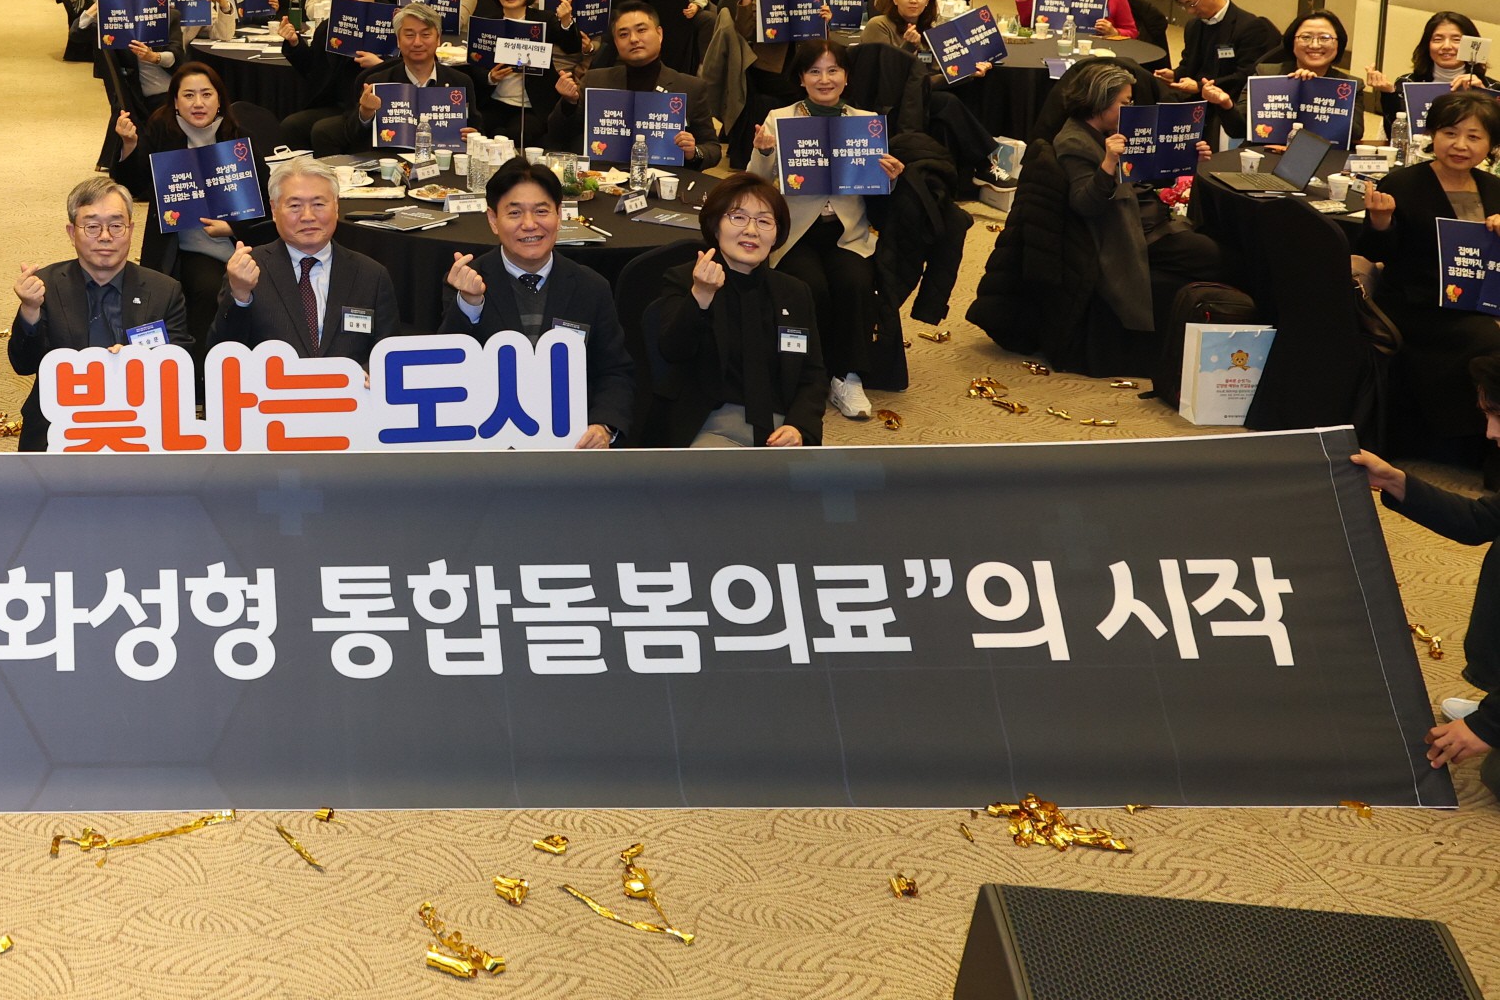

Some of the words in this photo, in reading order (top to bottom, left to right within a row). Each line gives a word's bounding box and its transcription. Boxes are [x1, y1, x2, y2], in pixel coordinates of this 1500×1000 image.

[503, 42, 546, 54] 화성특례시의원
[1268, 95, 1289, 103] 집에서
[1313, 97, 1336, 106] 화성형
[603, 110, 623, 118] 집에서
[648, 113, 668, 121] 화성형
[1315, 114, 1329, 123] 시작
[1134, 128, 1152, 136] 집에서
[1173, 125, 1191, 134] 화성형
[651, 130, 664, 139] 시작
[797, 139, 819, 147] 집에서
[846, 138, 868, 147] 화성형
[1174, 142, 1186, 151] 시작
[850, 158, 866, 166] 시작
[216, 163, 237, 175] 화성형
[171, 172, 192, 182] 집에서
[223, 182, 238, 193] 시작
[1458, 246, 1479, 257] 집에서
[56, 355, 358, 452] 빛나는
[378, 342, 570, 444] 도시
[1096, 557, 1294, 666] 시작
